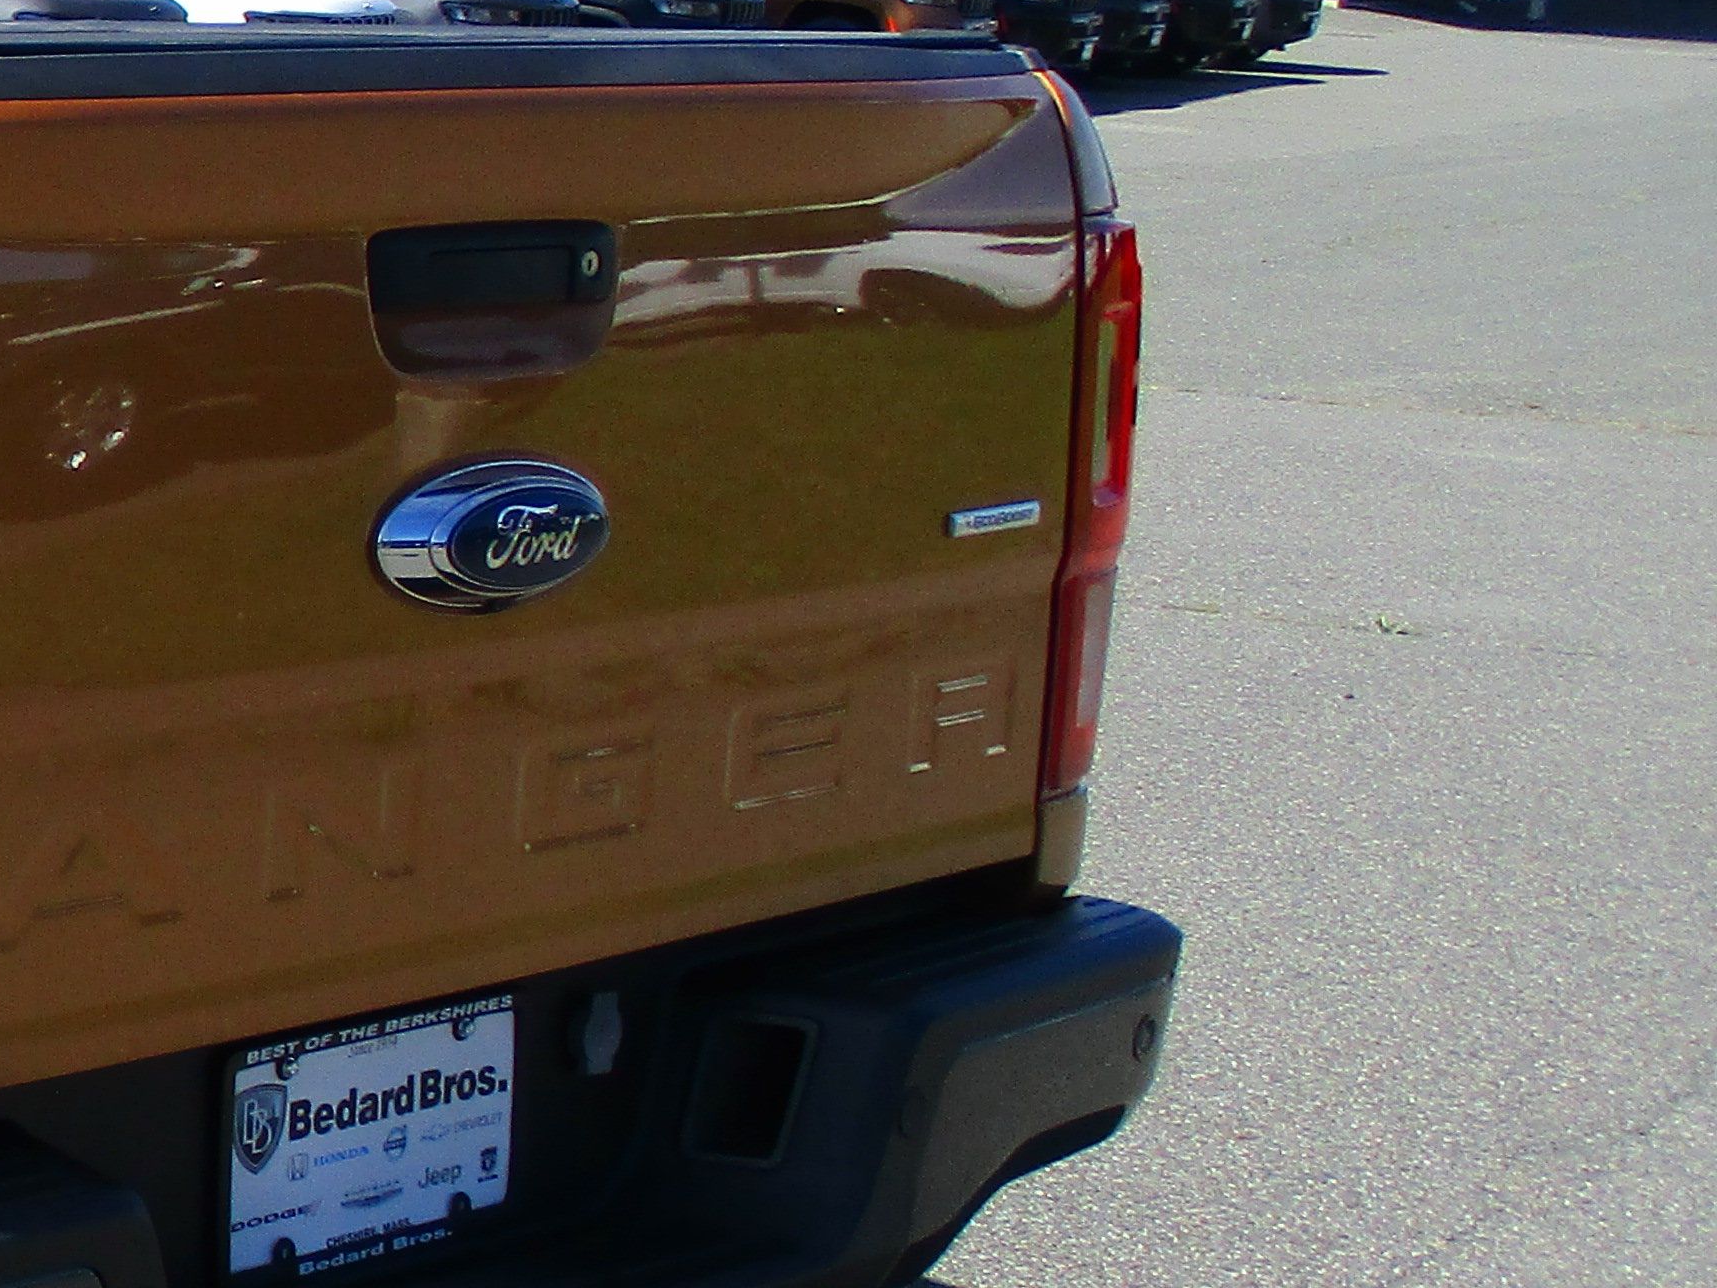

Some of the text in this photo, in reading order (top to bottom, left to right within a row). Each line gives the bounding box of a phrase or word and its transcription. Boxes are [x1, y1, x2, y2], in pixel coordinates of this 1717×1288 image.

[485, 502, 600, 571] Ford
[246, 994, 514, 1065] BEST OF THE BERKSHIRES
[417, 1164, 462, 1189] Jeep
[298, 1241, 385, 1276] Bedard
